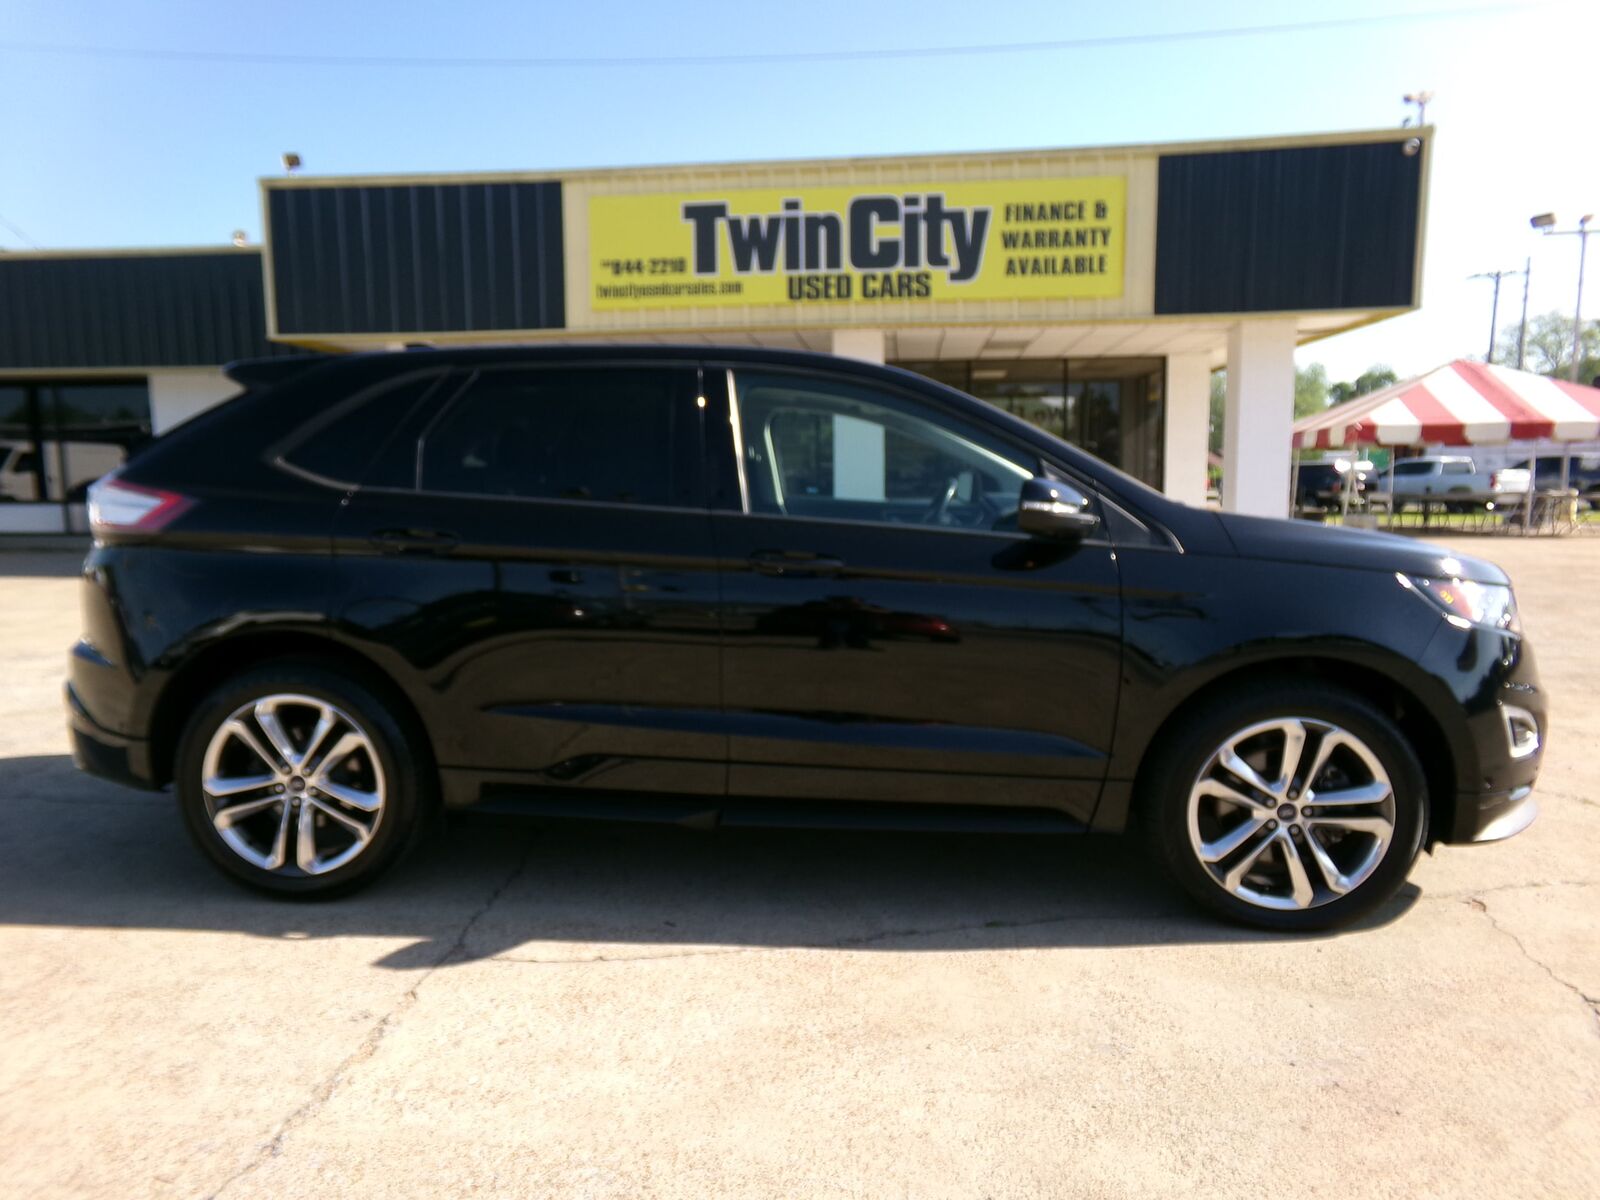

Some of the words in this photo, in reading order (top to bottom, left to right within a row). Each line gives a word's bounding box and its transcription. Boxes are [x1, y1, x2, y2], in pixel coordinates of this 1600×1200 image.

[1004, 201, 1085, 223] FINANCE
[1002, 227, 1111, 249] WARRANTY
[1005, 253, 1106, 277] AVAILABLE
[788, 273, 853, 301] USED
[861, 272, 932, 299] CARS
